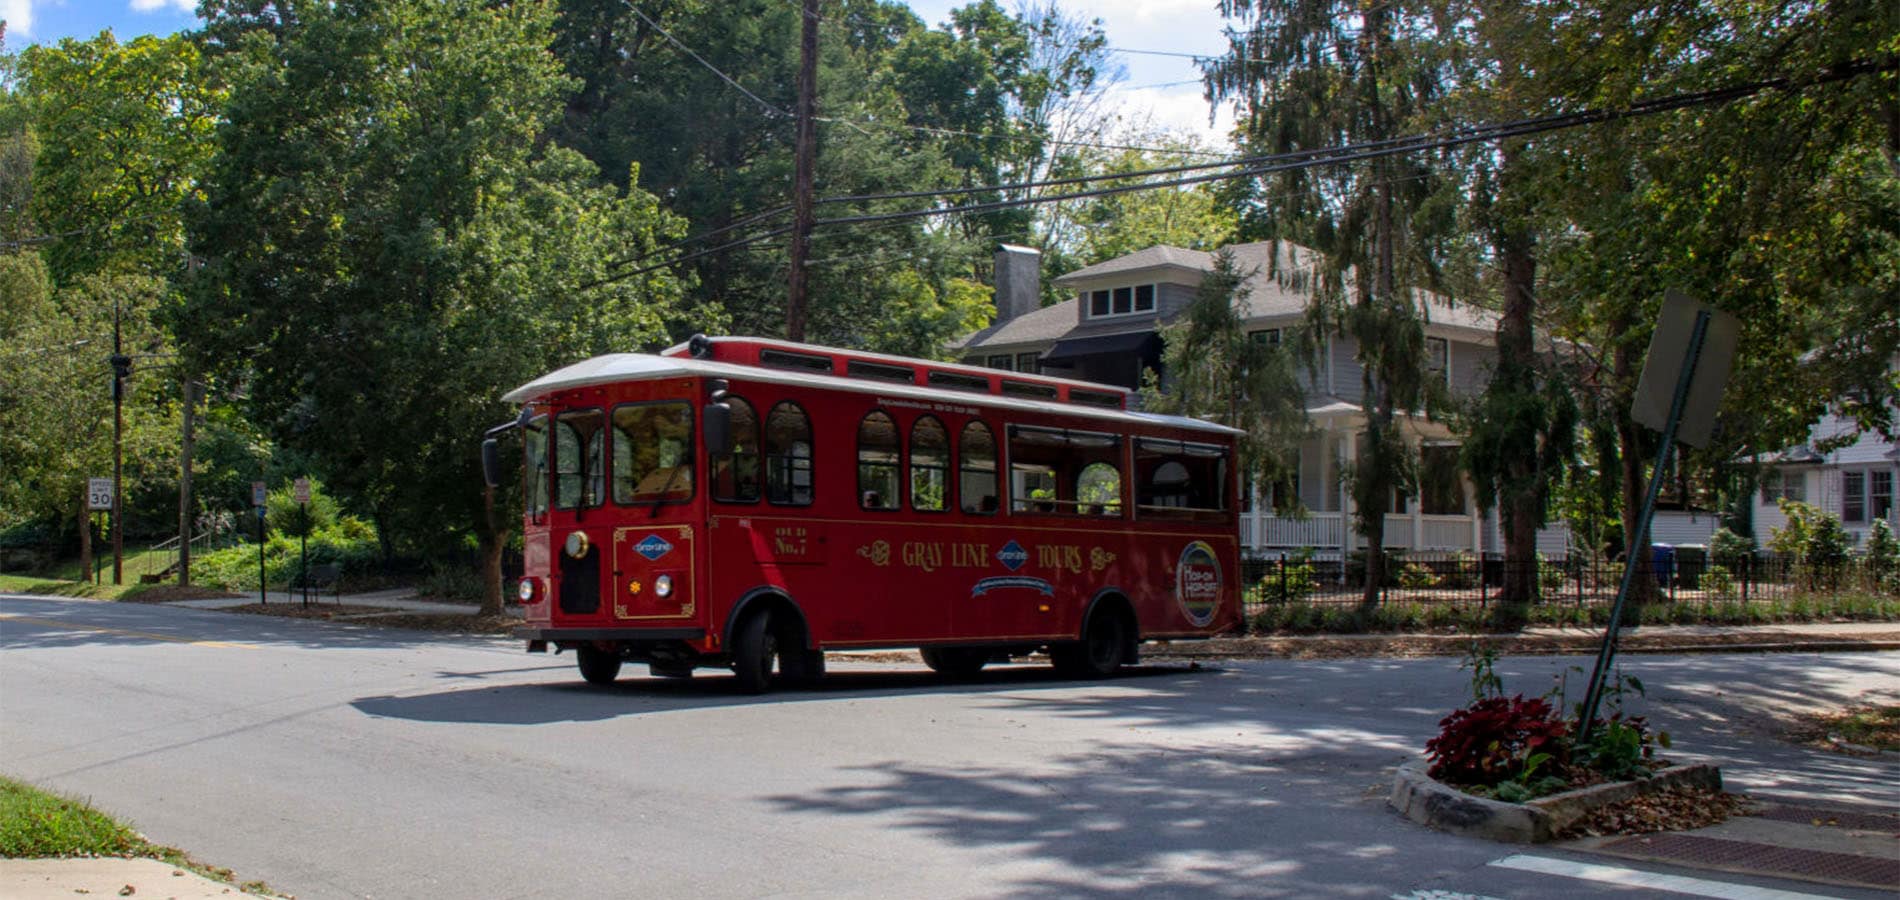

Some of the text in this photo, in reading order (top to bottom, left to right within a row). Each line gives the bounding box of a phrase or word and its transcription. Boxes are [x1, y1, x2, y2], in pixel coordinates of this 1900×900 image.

[91, 493, 110, 505] 30
[775, 527, 807, 537] OLD
[902, 542, 991, 572] GRAY LINE
[1035, 544, 1083, 574] TOURS
